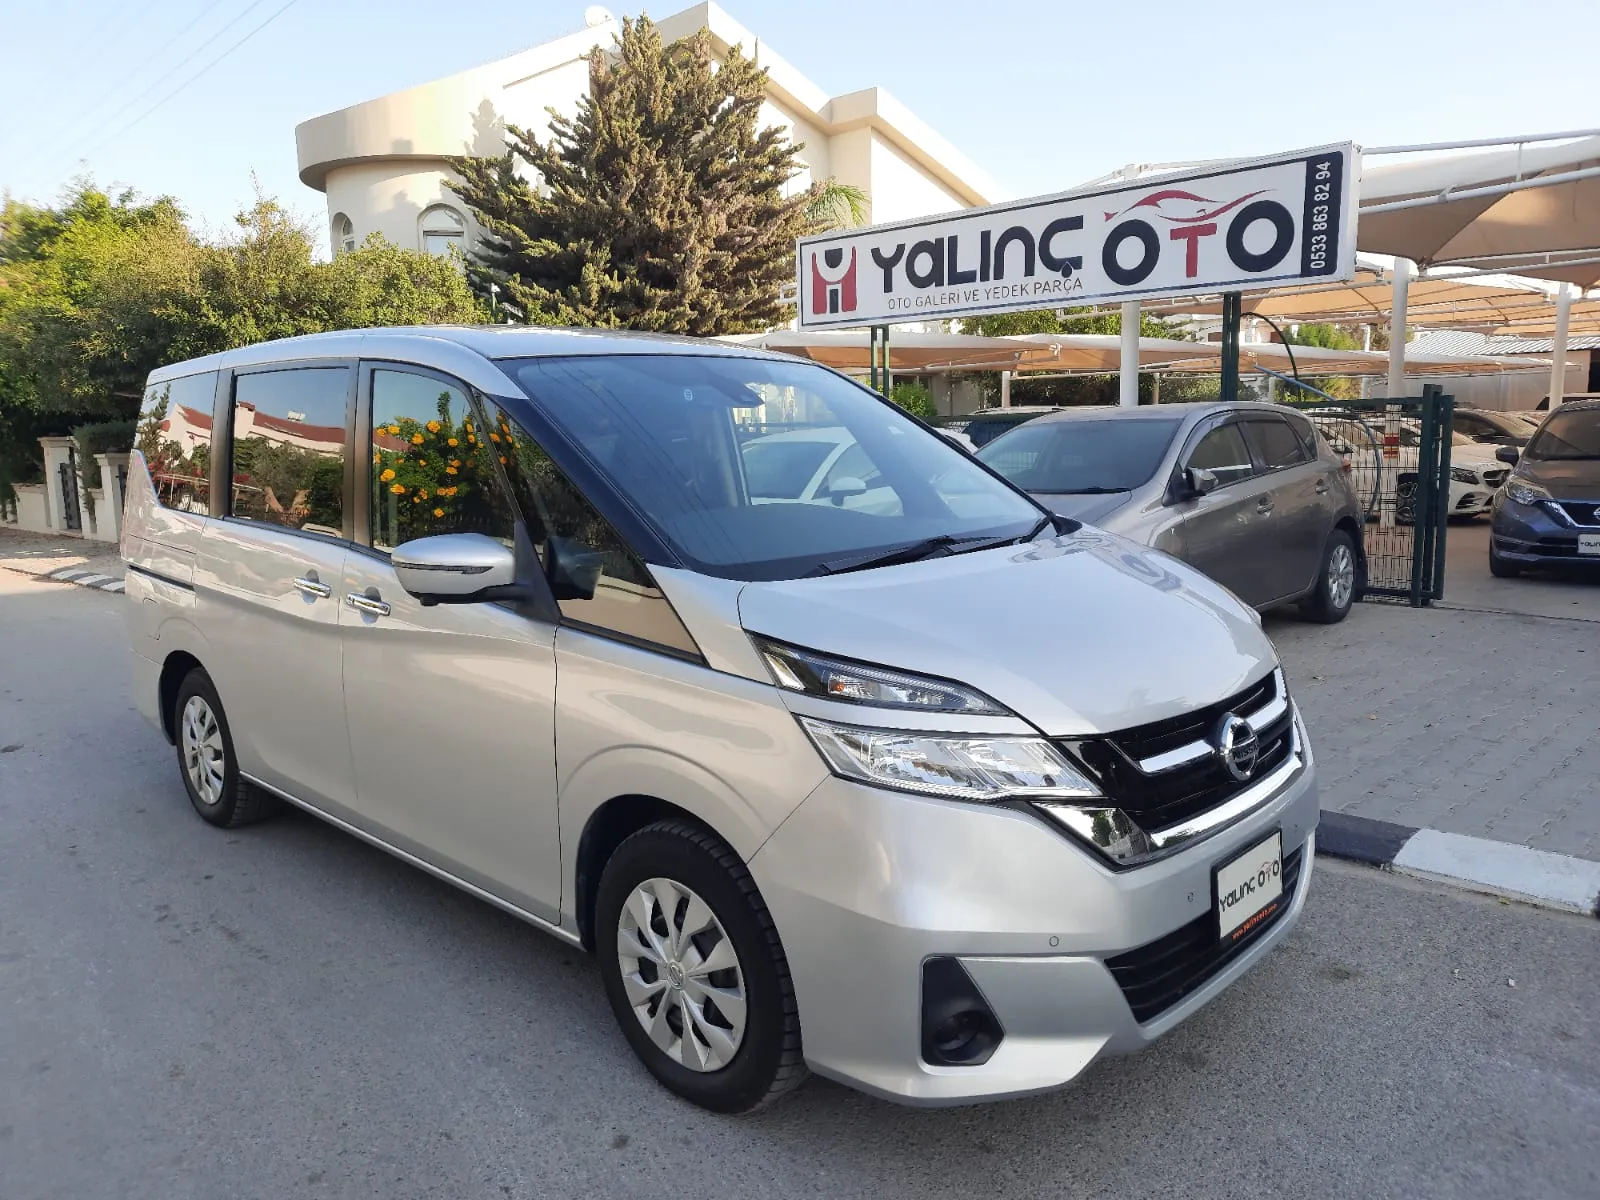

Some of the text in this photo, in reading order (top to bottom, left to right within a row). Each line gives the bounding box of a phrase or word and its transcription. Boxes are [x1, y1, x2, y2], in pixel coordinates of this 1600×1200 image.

[1102, 200, 1295, 286] OTO
[1310, 161, 1331, 269] 0533 863 82 94
[888, 298, 911, 310] OTO
[964, 289, 980, 302] VE
[984, 283, 1030, 300] YEDEK
[1034, 277, 1083, 294] PARÇA
[1258, 860, 1280, 887] OTO
